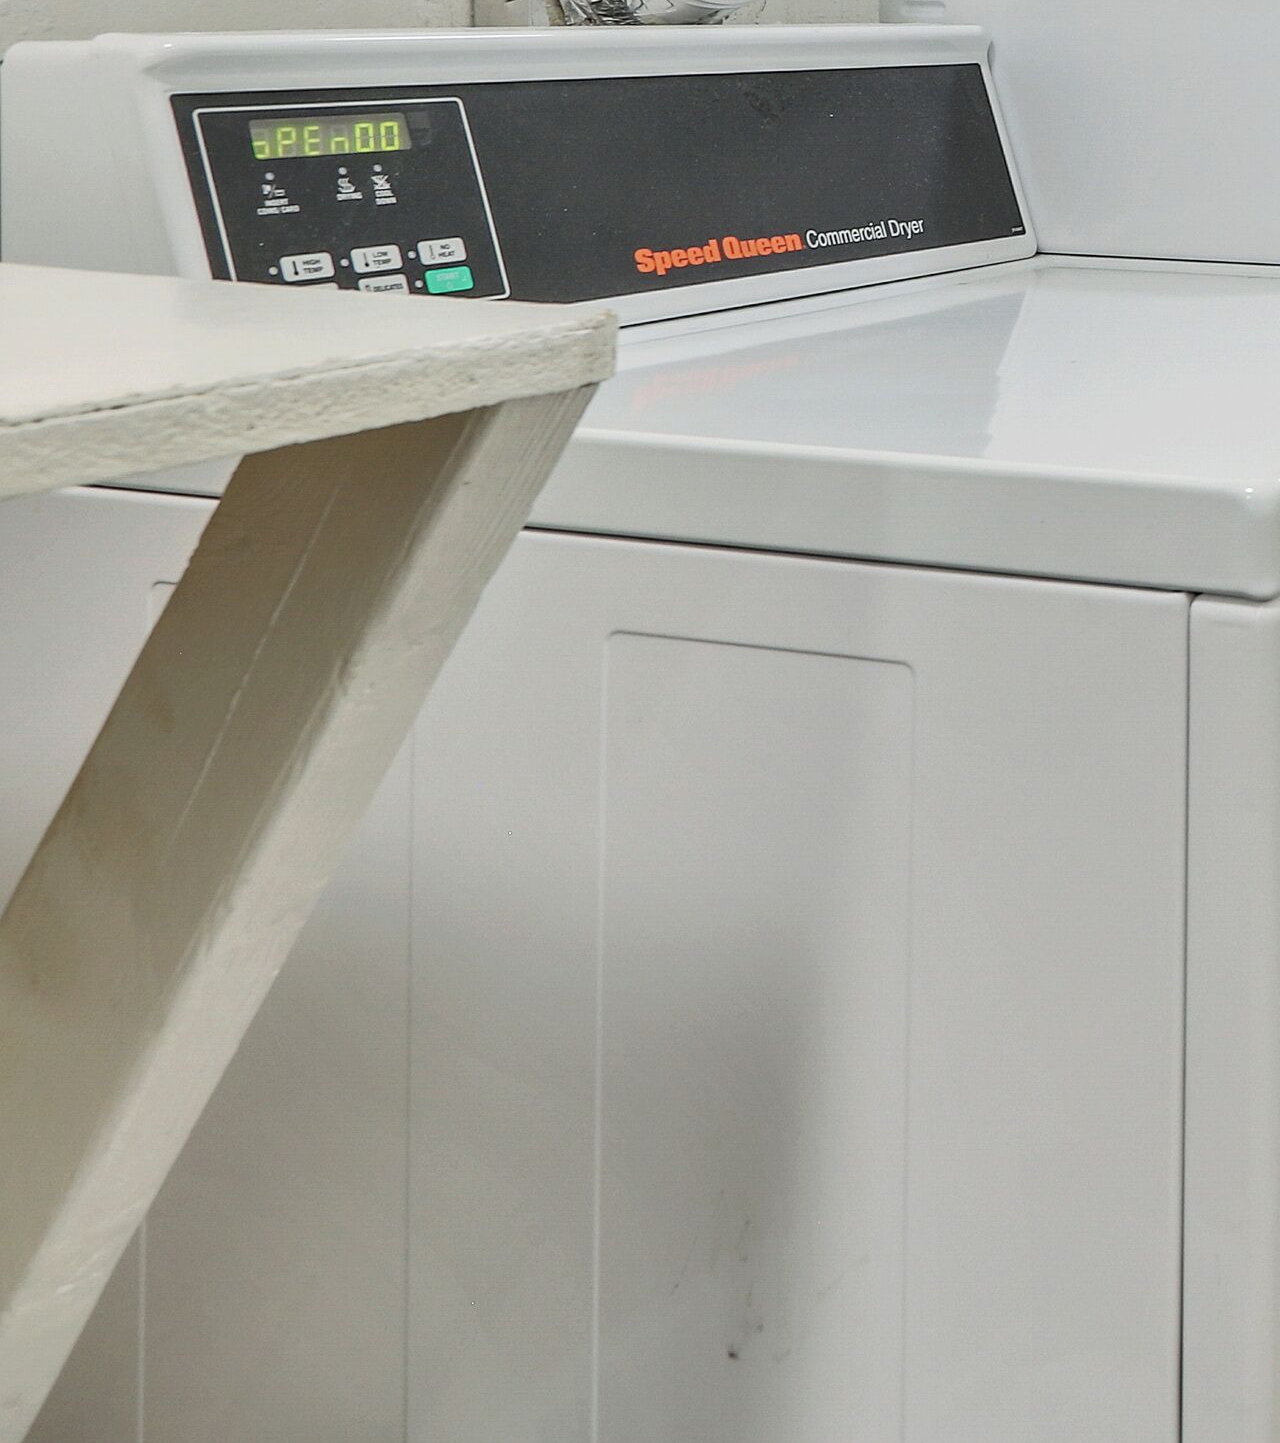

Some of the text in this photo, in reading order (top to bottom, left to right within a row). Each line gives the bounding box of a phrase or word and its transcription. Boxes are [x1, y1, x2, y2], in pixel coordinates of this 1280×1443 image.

[634, 217, 926, 276] Speed Queen Commercial Dryer
[438, 250, 455, 258] HEAT
[373, 258, 392, 266] TEMP
[303, 266, 324, 274] TEMP
